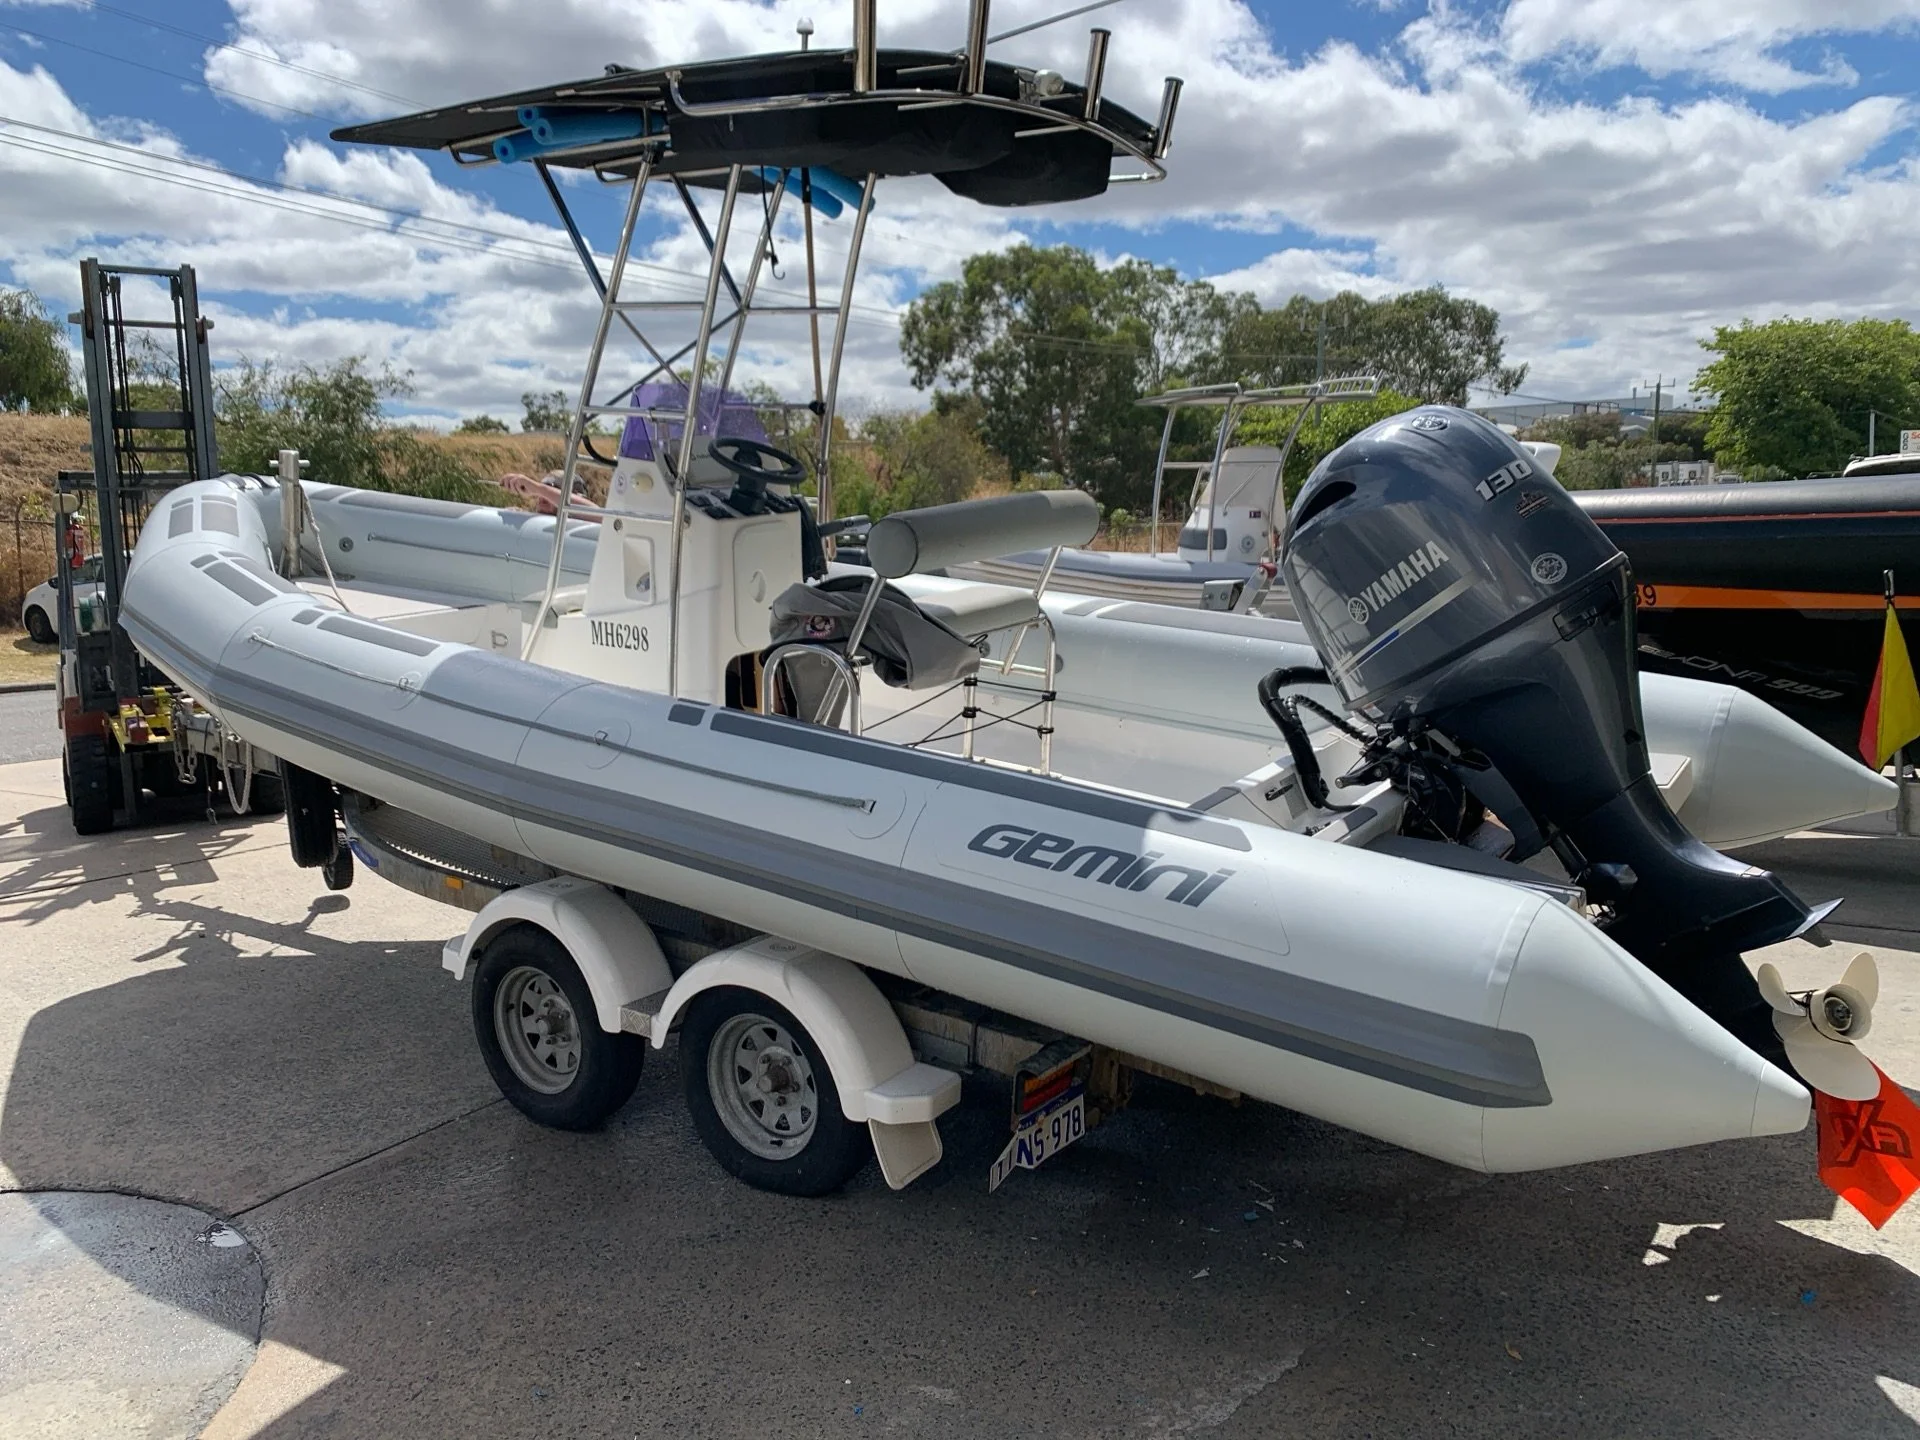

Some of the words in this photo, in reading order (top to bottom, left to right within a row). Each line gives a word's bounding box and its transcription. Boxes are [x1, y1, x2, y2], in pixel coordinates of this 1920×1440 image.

[1475, 460, 1533, 501] 130
[1360, 540, 1449, 612] YAMAHA
[590, 620, 649, 652] MH6298
[1765, 678, 1845, 700] 999
